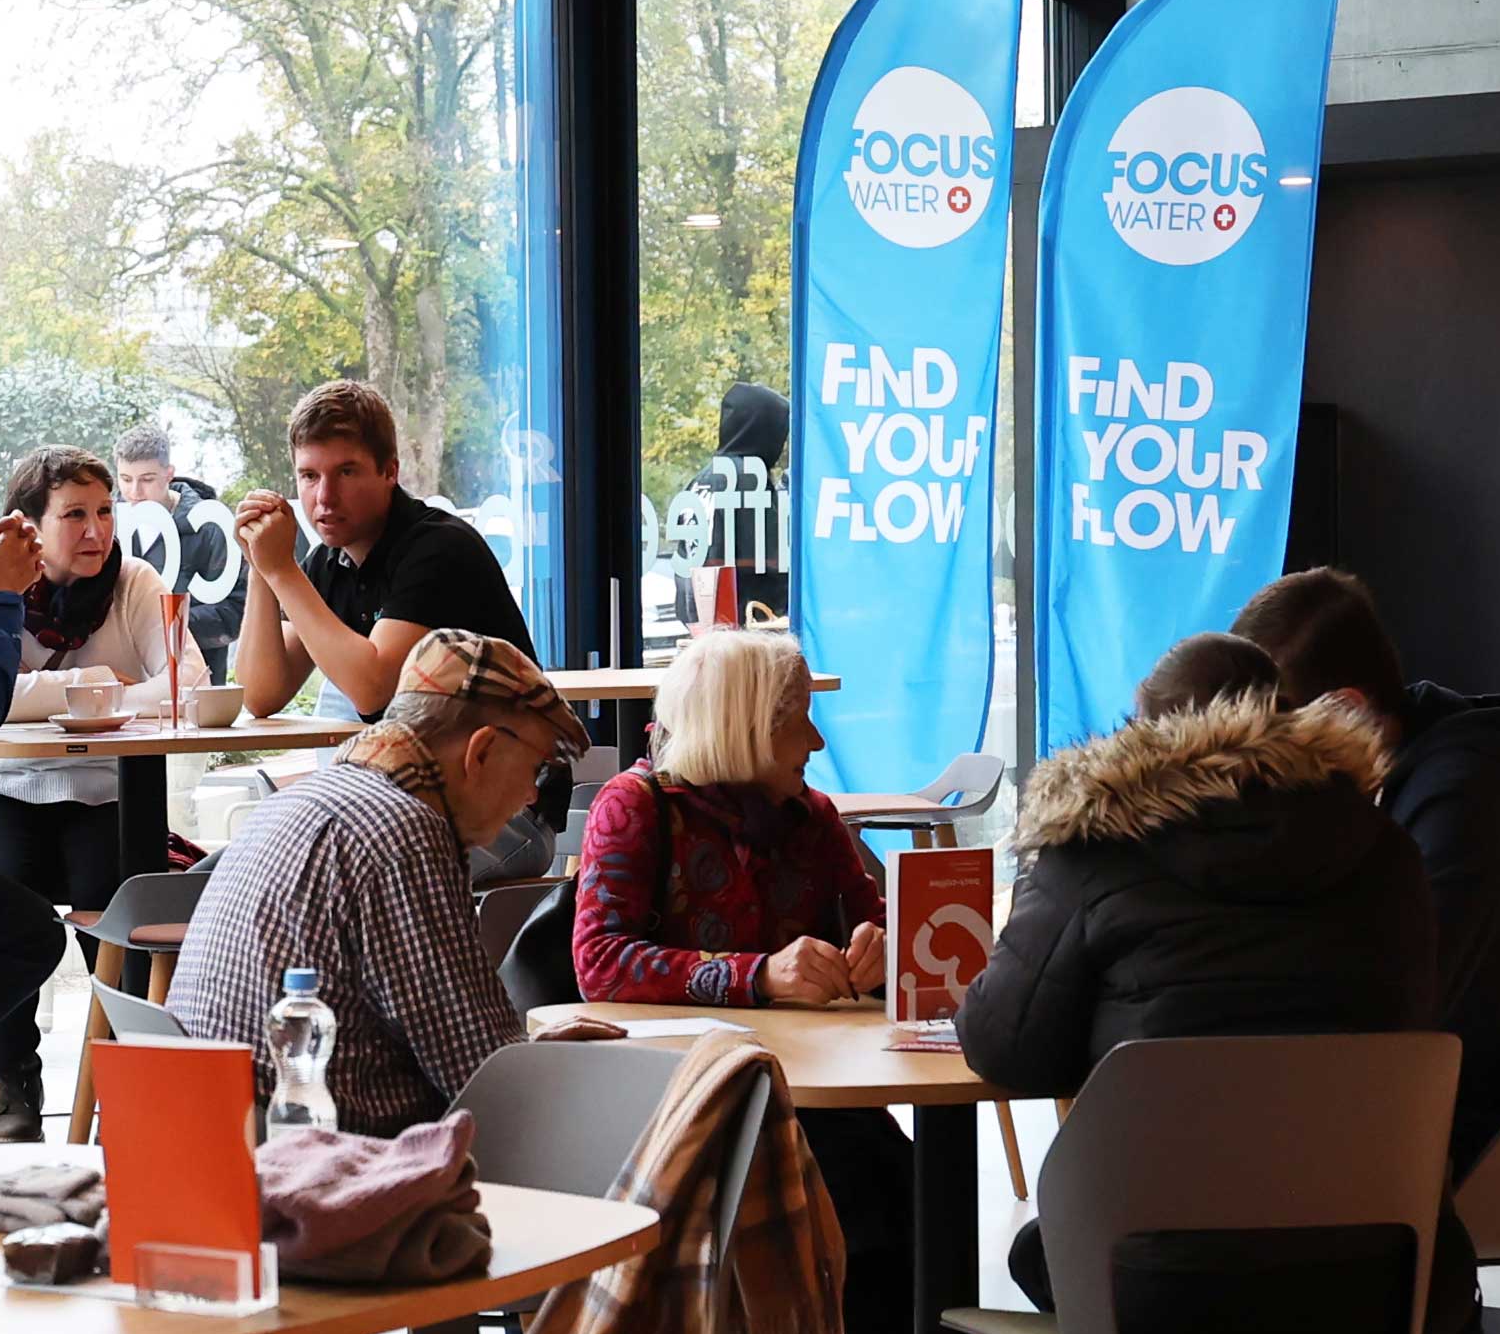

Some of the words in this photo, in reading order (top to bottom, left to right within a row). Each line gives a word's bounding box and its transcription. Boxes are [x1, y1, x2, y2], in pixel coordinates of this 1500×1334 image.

[844, 128, 997, 179] FOCUS
[1104, 150, 1269, 198] FOCUS
[853, 180, 940, 213] WATER
[1111, 200, 1206, 232] WATER
[821, 342, 959, 409] FIND
[1068, 355, 1214, 422] FIND
[1082, 422, 1268, 491] YOUR
[814, 476, 966, 544] FLOW
[1072, 482, 1237, 555] FLOW
